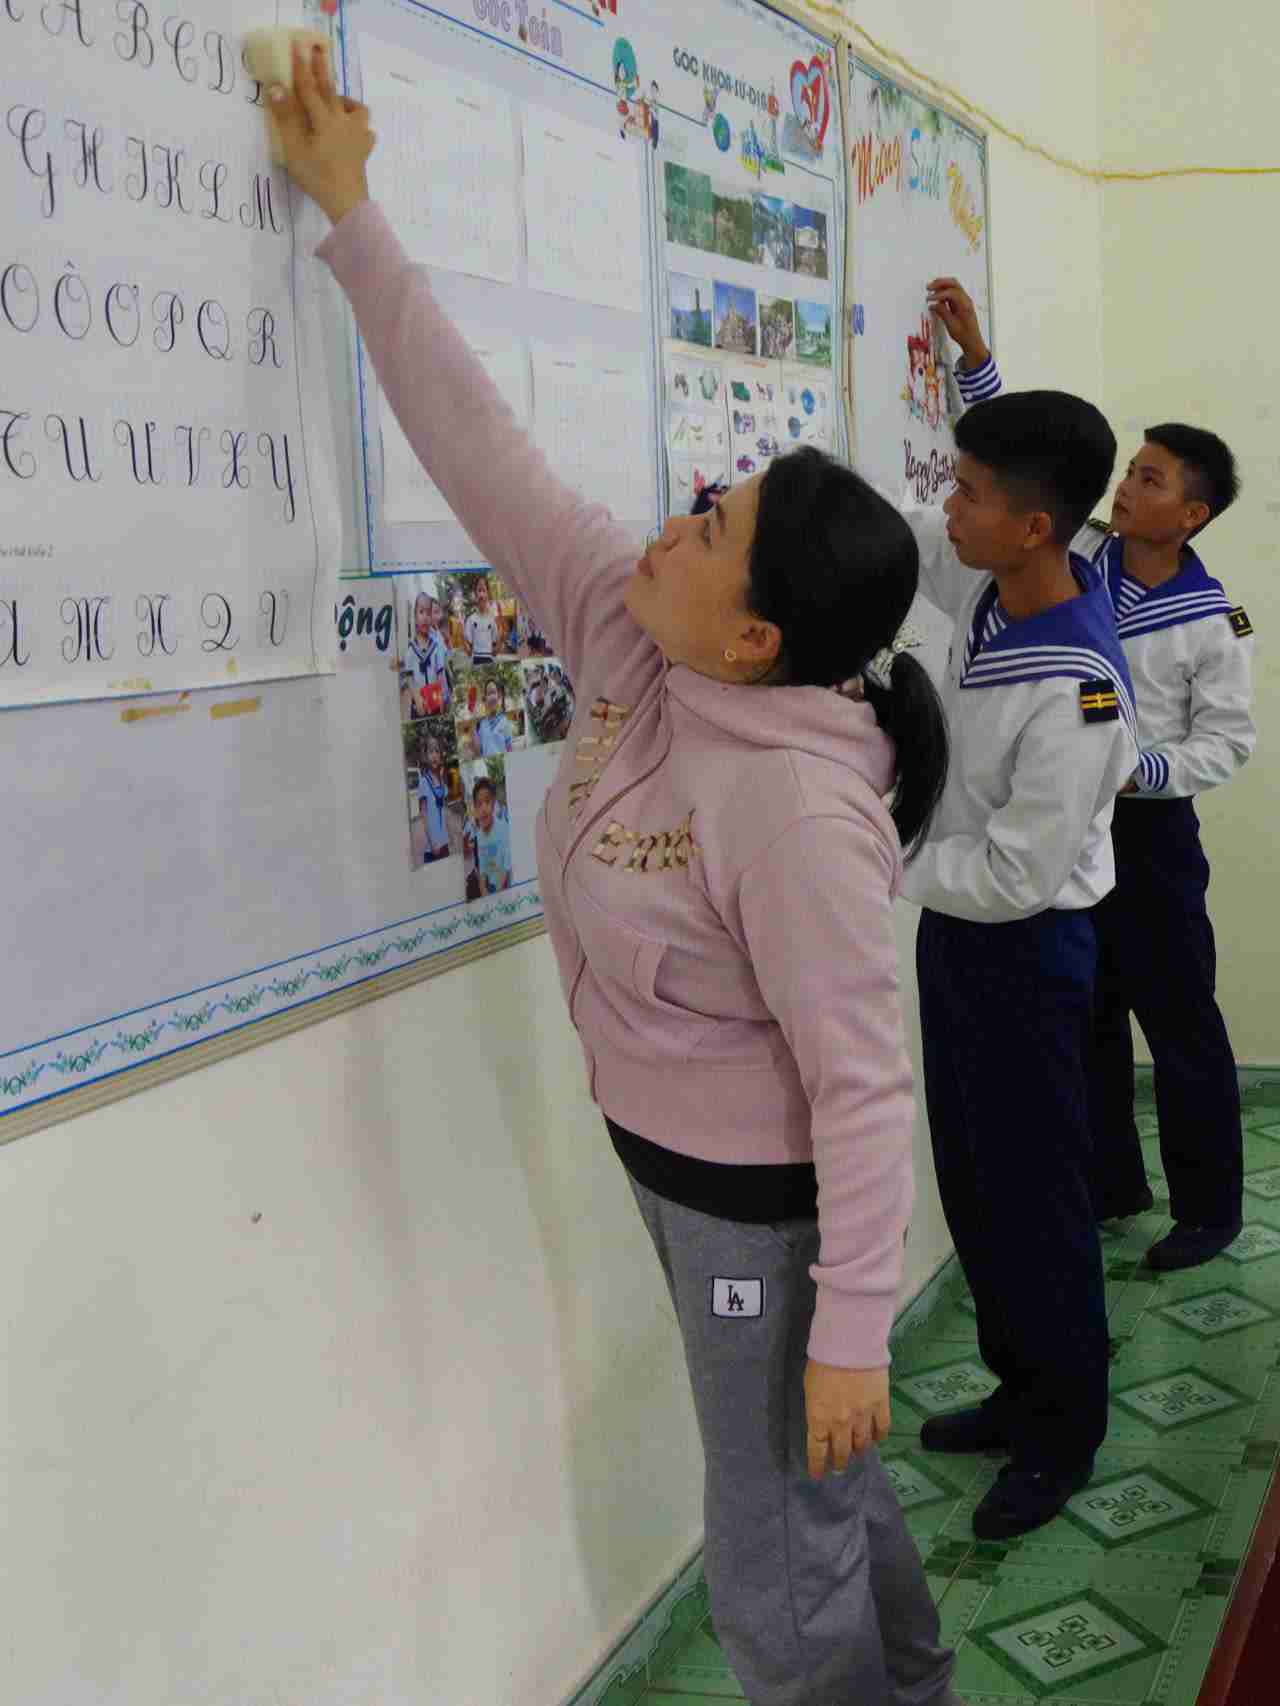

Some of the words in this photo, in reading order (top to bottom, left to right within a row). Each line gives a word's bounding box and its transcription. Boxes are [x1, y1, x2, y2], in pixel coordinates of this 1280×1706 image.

[113, 0, 154, 69] B
[164, 16, 199, 83] C
[239, 173, 281, 235] M
[54, 259, 92, 341] Ô
[151, 291, 184, 352] P
[246, 306, 284, 369] R
[334, 594, 393, 652] ộng
